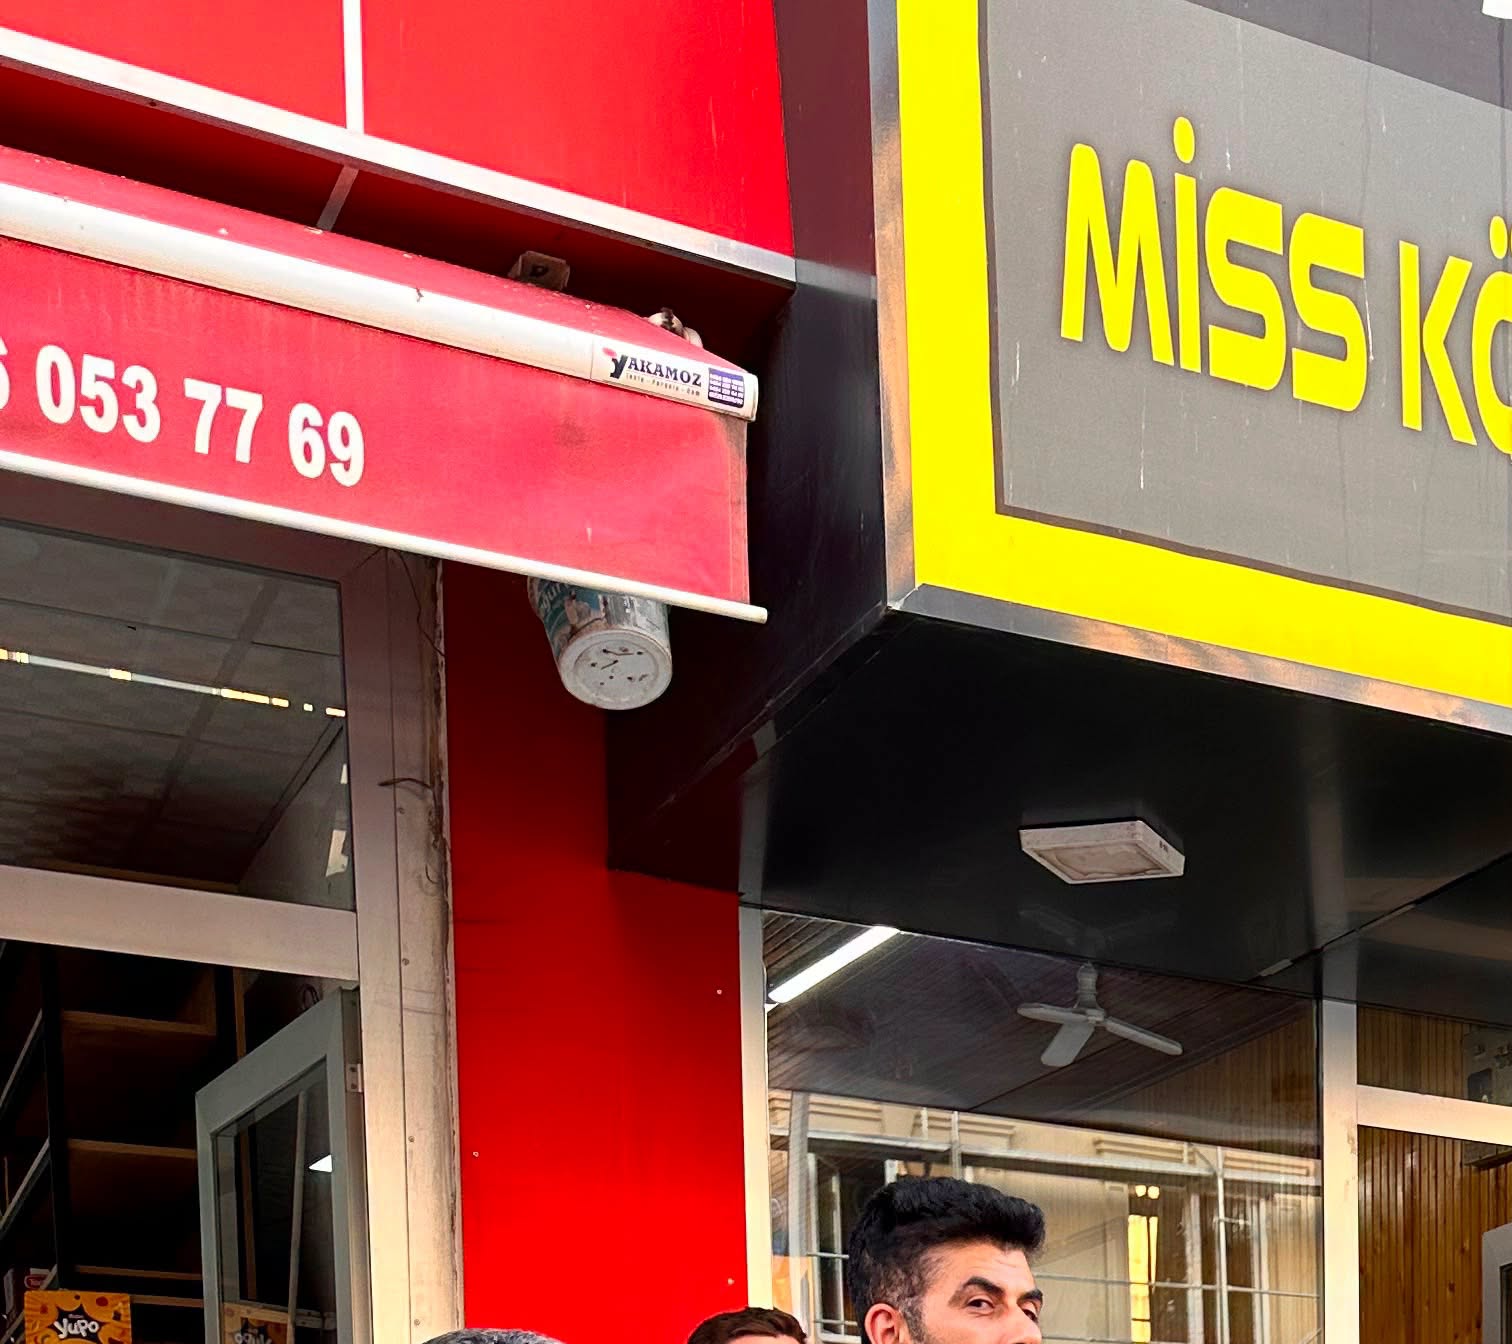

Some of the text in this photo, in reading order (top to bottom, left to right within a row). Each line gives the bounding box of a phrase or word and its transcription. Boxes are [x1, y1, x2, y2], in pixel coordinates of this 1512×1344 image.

[1061, 117, 1368, 412] MİSS
[36, 345, 161, 443] 053
[184, 377, 263, 464] 77
[288, 403, 365, 487] 69
